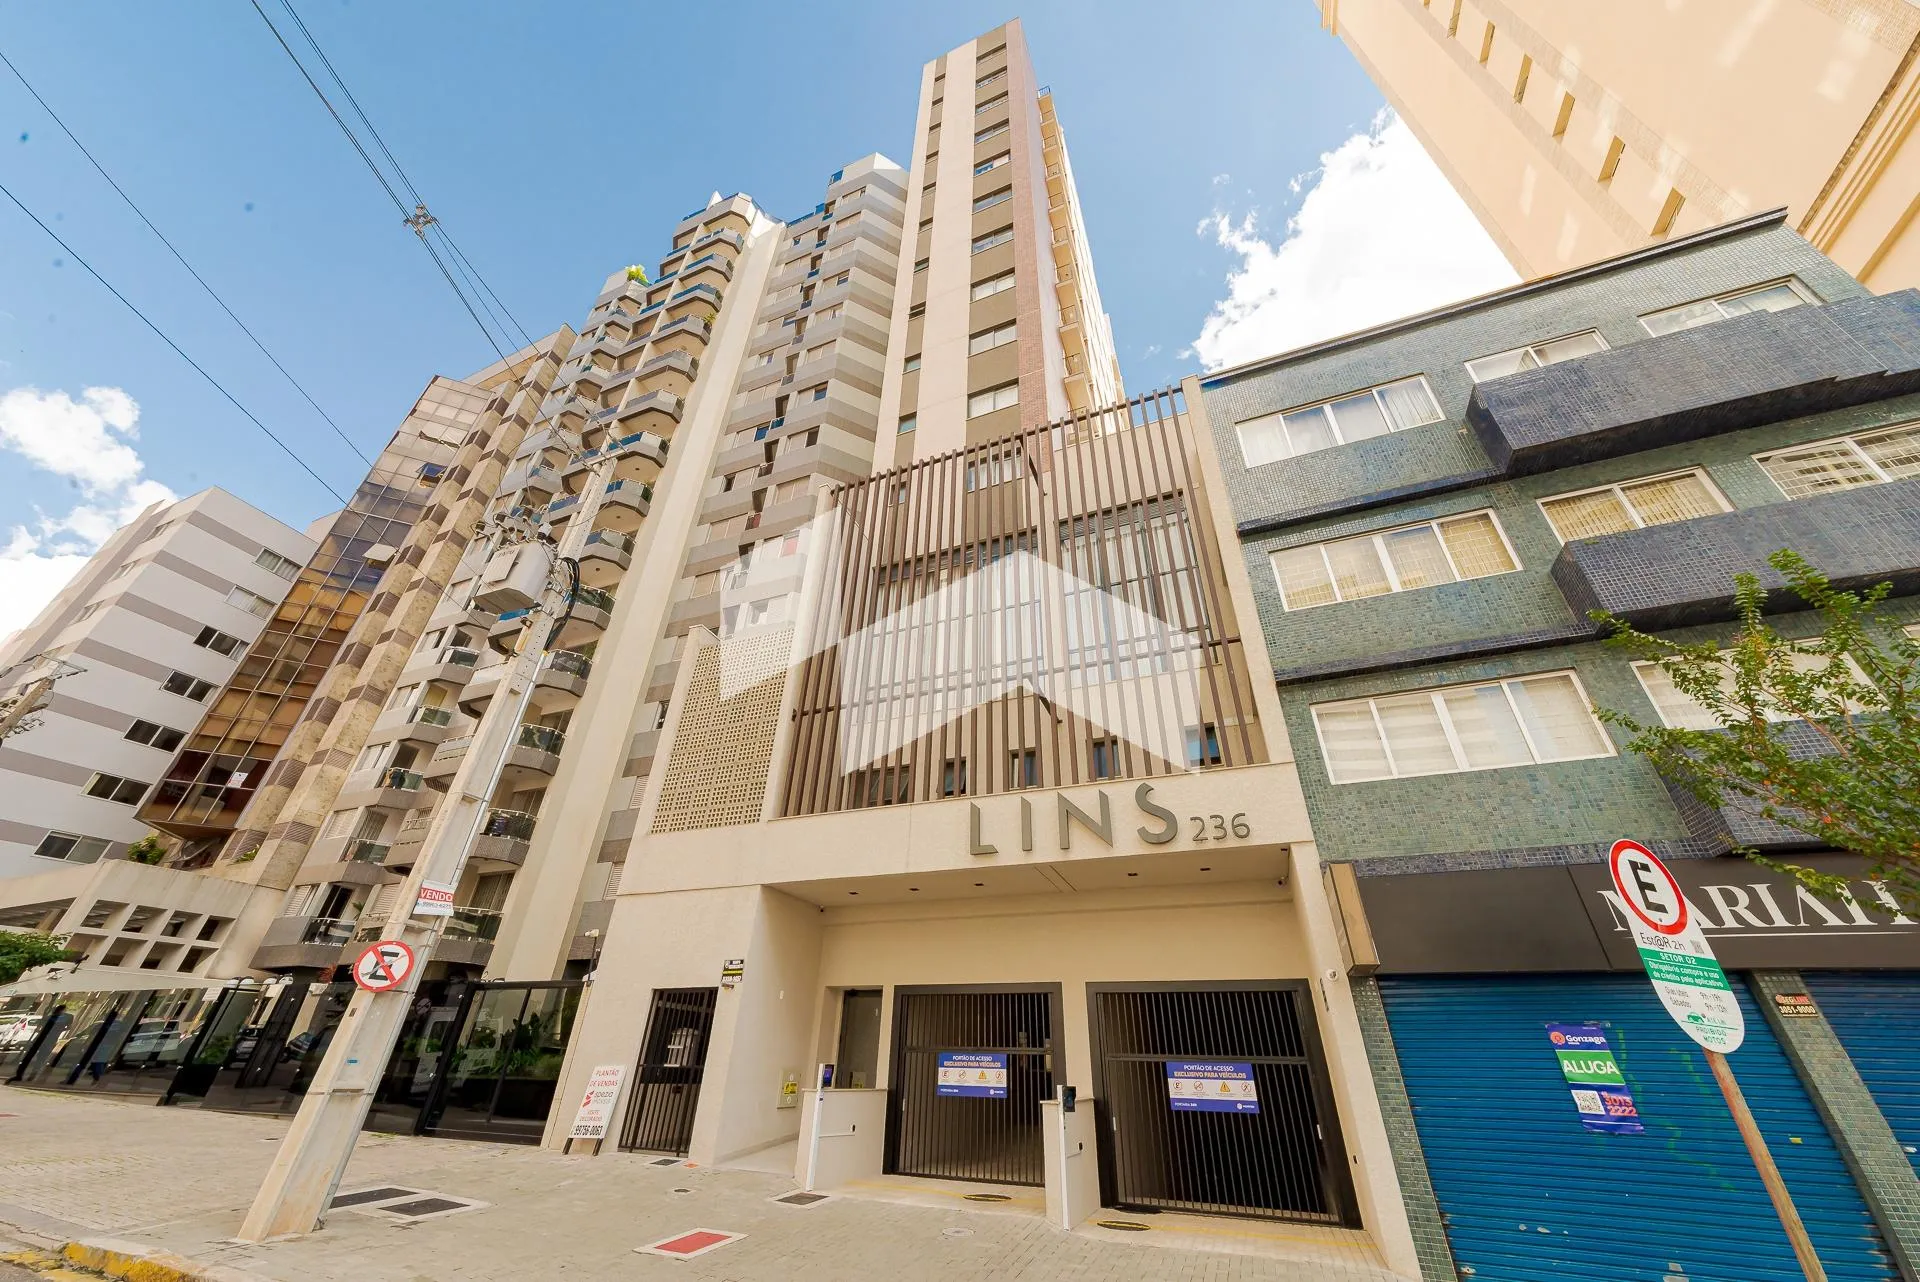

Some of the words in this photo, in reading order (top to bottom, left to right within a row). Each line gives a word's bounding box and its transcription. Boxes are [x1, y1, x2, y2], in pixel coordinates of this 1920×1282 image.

[970, 782, 1178, 855] LINS
[1189, 812, 1251, 842] 236
[1628, 859, 1669, 915] E
[421, 889, 453, 902] VENDO
[1672, 940, 1687, 952] 2h
[1659, 952, 1684, 963] SETOR
[1685, 956, 1698, 965] 02
[1680, 967, 1704, 977] compra
[1565, 1035, 1607, 1045] Gonzaga
[596, 1069, 619, 1077] PLANTÃO
[1563, 1060, 1620, 1075] ALUGA
[1219, 1071, 1246, 1079] VEÍCULOS
